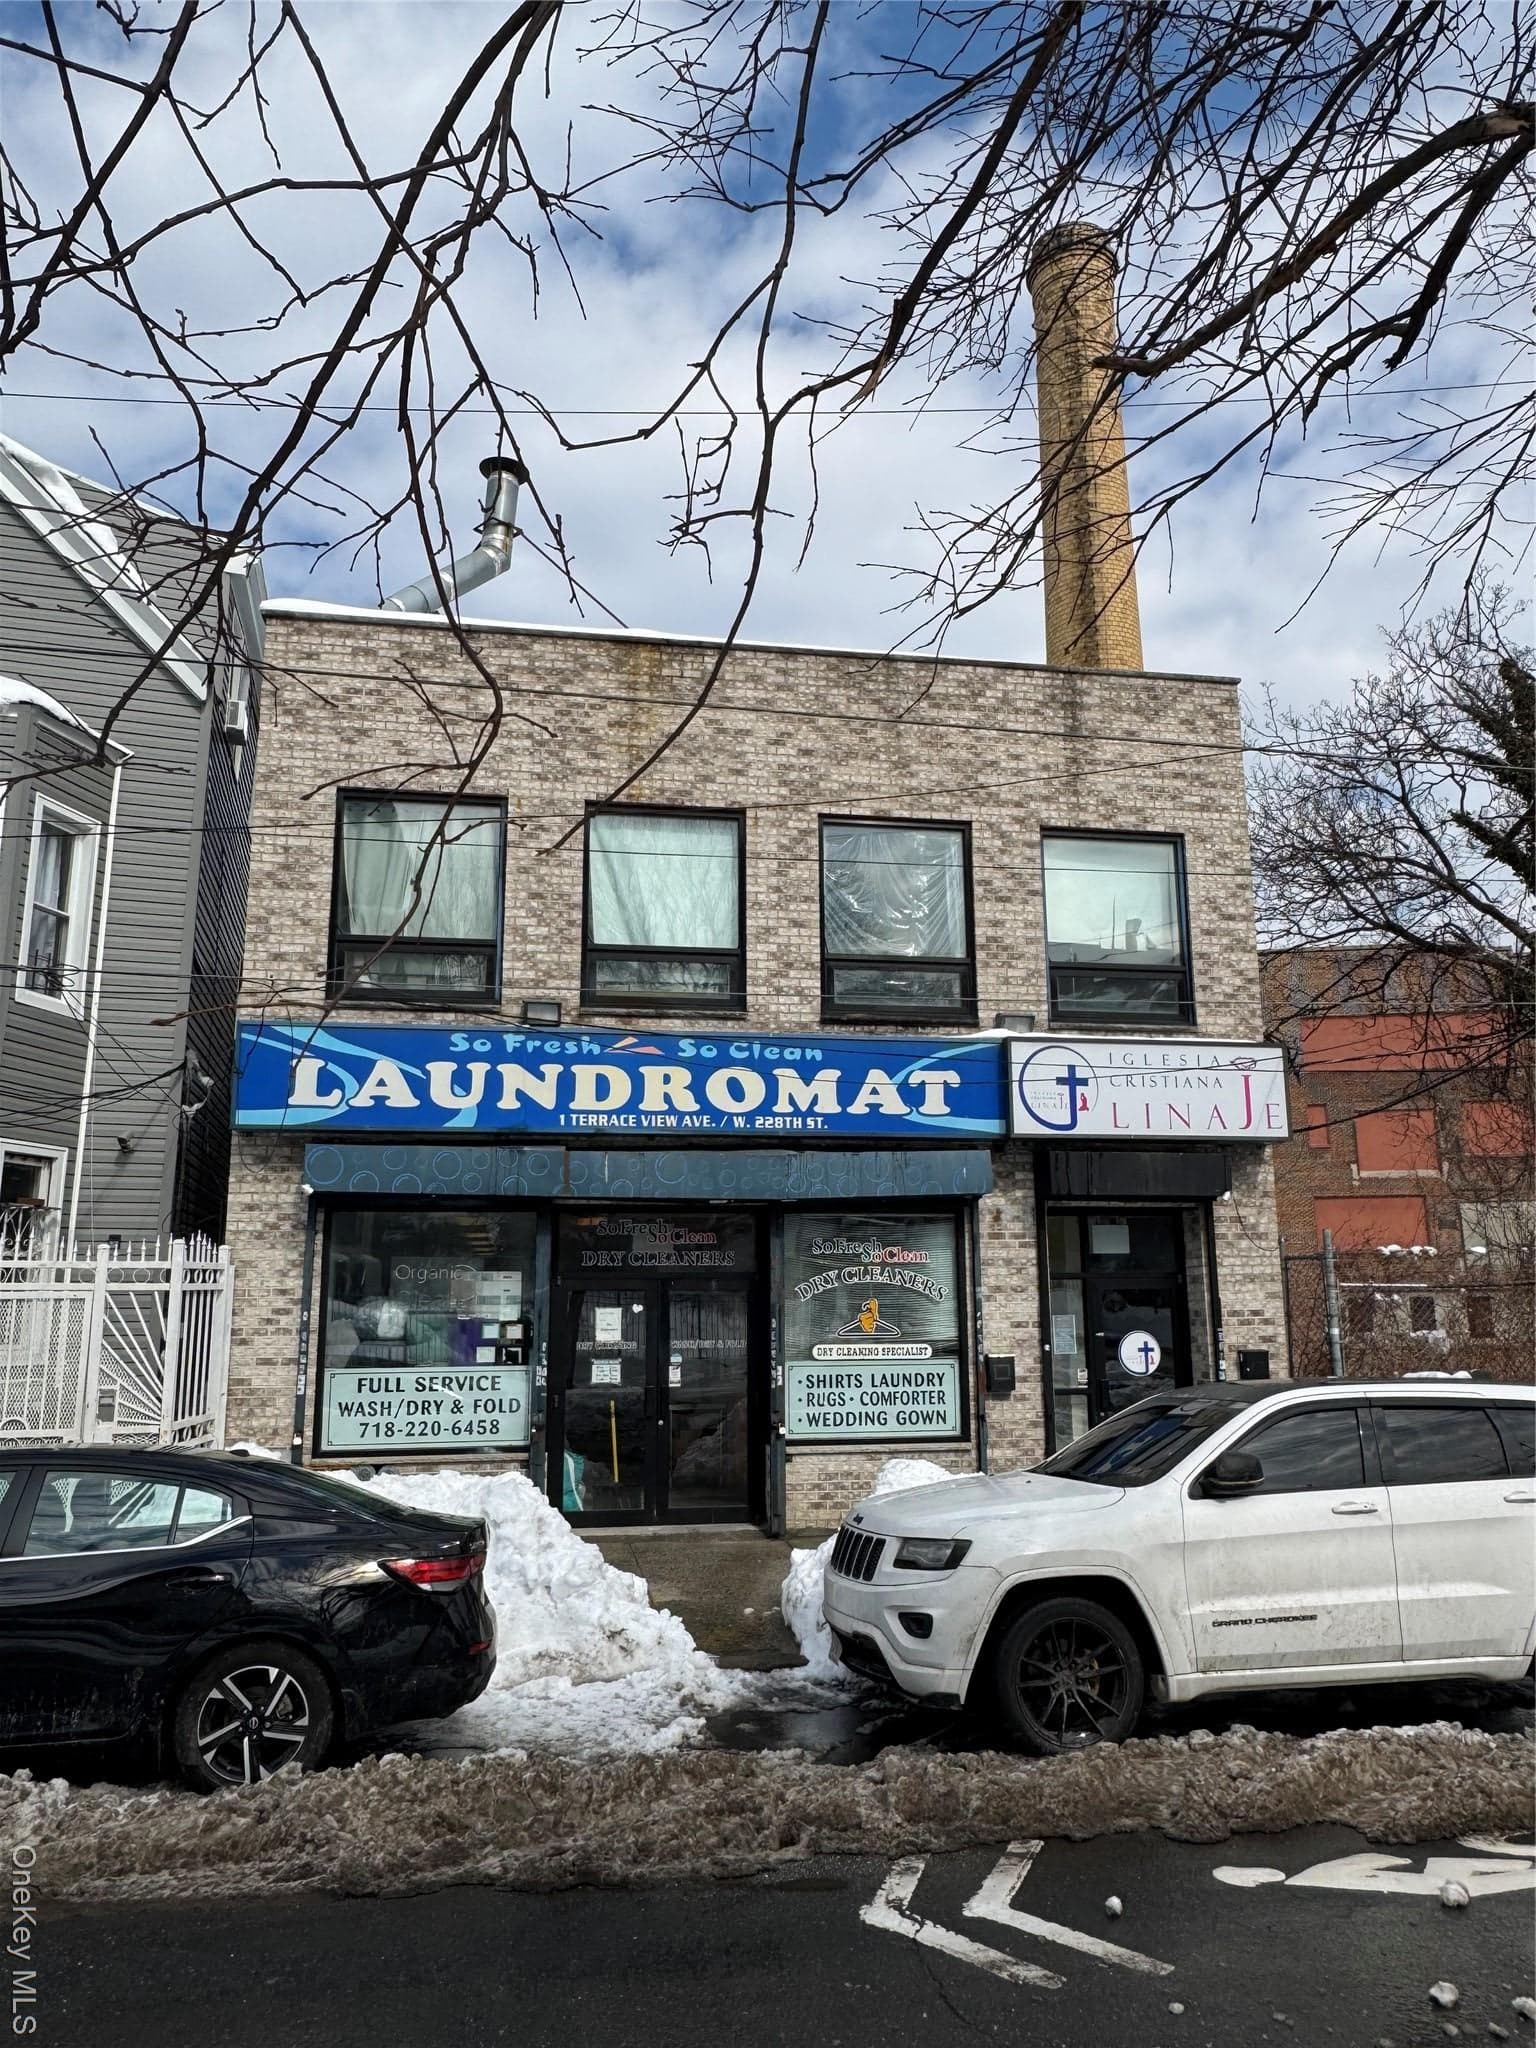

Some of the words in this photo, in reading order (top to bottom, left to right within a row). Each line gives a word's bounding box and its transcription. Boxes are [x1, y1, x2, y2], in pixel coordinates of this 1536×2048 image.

[449, 1033, 493, 1053] So
[503, 1034, 601, 1056] Fresh
[678, 1038, 718, 1059] So
[729, 1041, 823, 1062] Clean
[1109, 1052, 1220, 1066] IGLESIA
[288, 1058, 960, 1116] LAUNDROMAT
[1109, 1075, 1223, 1089] CRISTIANA
[1112, 1074, 1284, 1130] LINAJE
[559, 1114, 565, 1126] 1
[570, 1114, 637, 1127] TERRACE
[641, 1115, 679, 1127] VIEW
[682, 1115, 716, 1128] AVE.
[733, 1116, 750, 1129] W.
[755, 1116, 802, 1129] 228TH
[806, 1117, 828, 1129] ST.
[581, 1250, 626, 1266] DRY
[628, 1250, 736, 1266] CLEANERS
[394, 1264, 464, 1284] Organic
[795, 1270, 839, 1302] DRY
[841, 1266, 949, 1302] CLEANERS
[816, 1347, 834, 1357] DRY
[836, 1347, 879, 1357] CLEANING
[881, 1346, 928, 1356] SPECIALIST
[357, 1377, 406, 1394] FULL
[415, 1375, 501, 1393] SERVICE
[806, 1373, 863, 1389] SHIRTS
[871, 1372, 945, 1388] LAUNDRY
[806, 1391, 846, 1407] RUGS
[859, 1390, 946, 1407] COMFORTER
[338, 1398, 444, 1418] WASH/DRY
[450, 1400, 464, 1415] &
[473, 1398, 521, 1415] FOLD
[806, 1411, 888, 1428] WEDDING
[896, 1410, 947, 1425] GOWN
[359, 1419, 500, 1438] 718-220-6458
